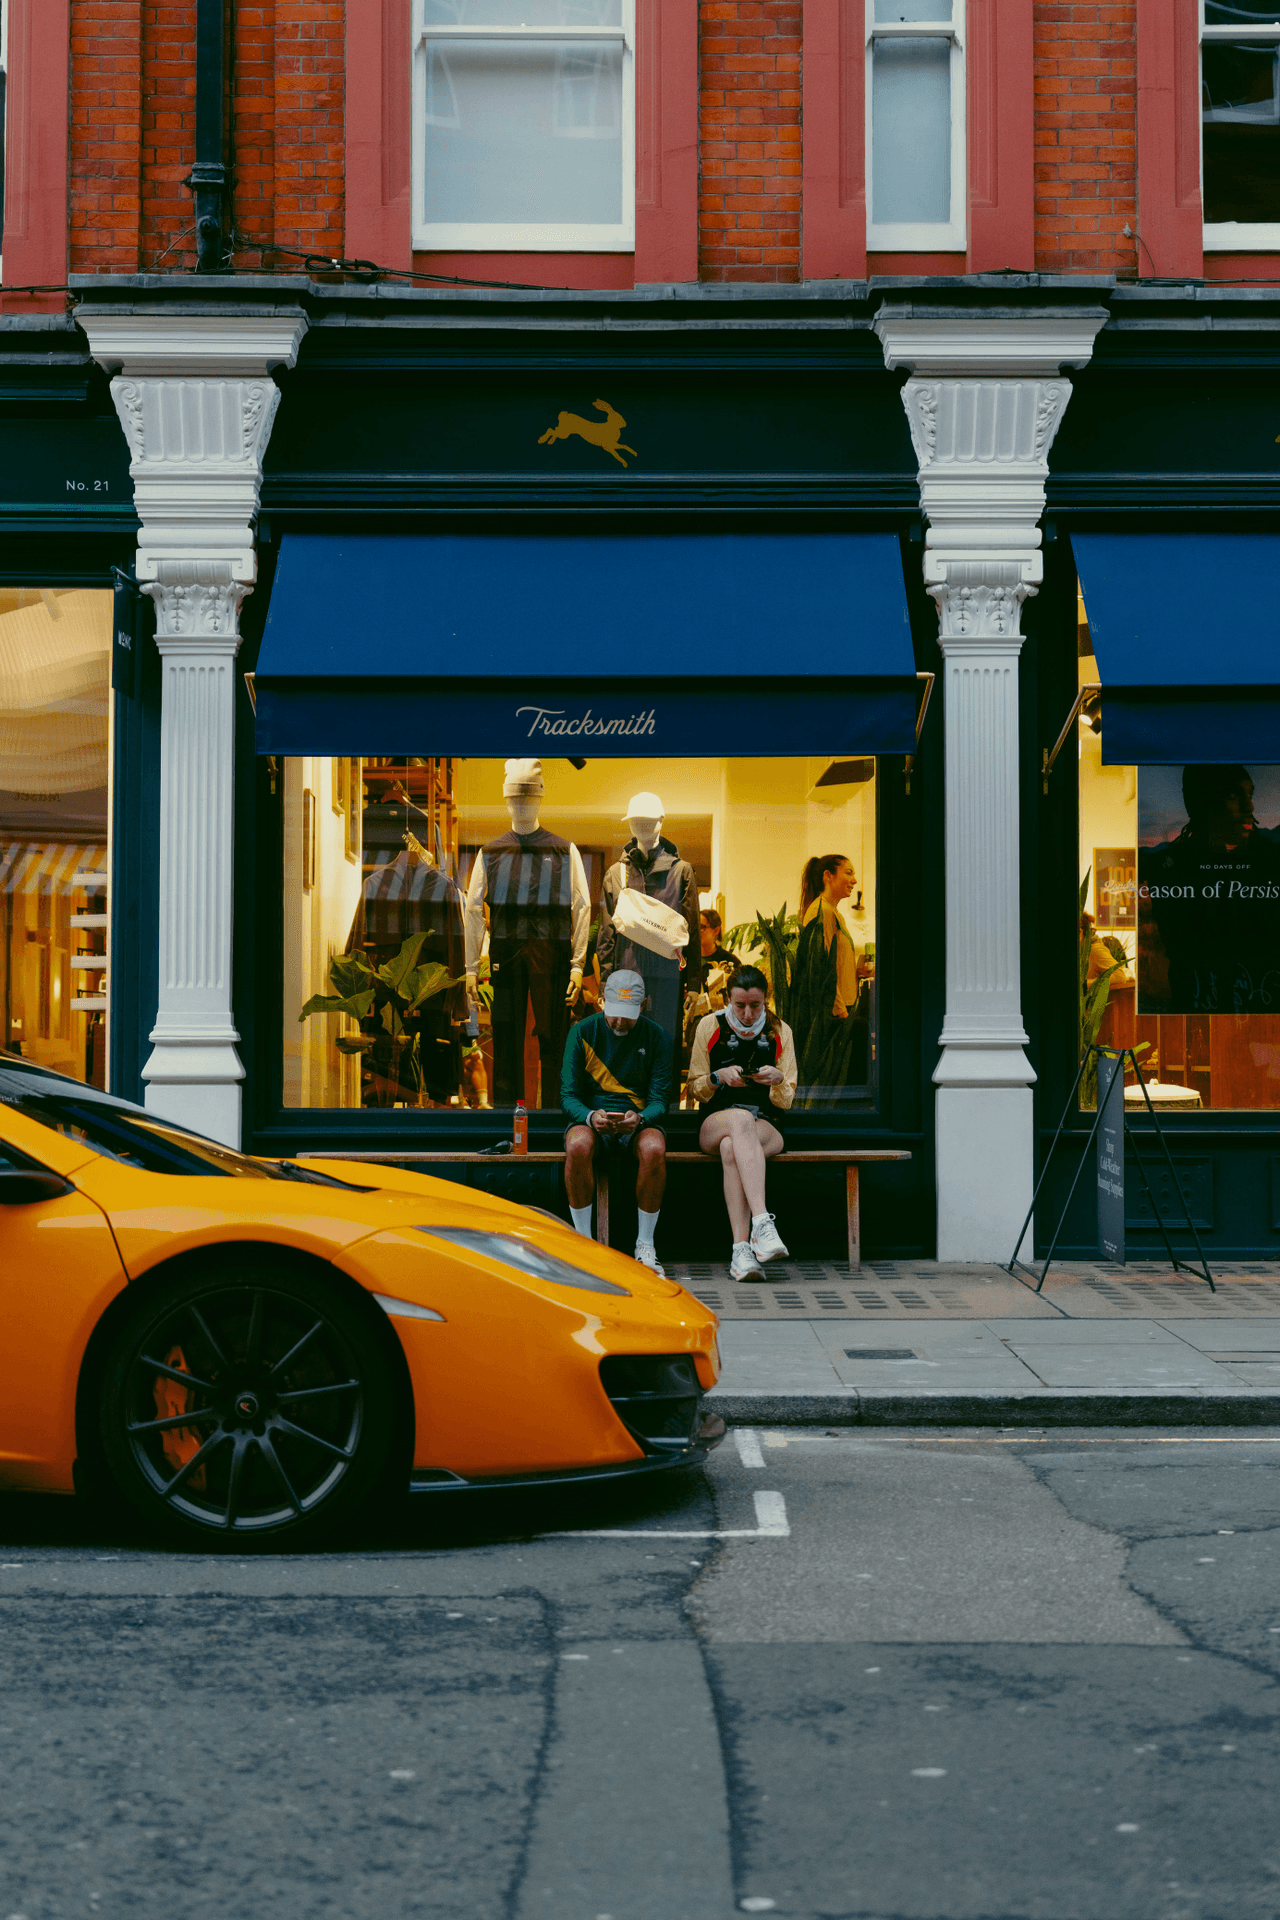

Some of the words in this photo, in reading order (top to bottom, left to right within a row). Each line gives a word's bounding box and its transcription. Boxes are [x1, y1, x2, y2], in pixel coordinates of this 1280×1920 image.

[66, 480, 89, 491] No.
[93, 480, 109, 491] 21
[515, 706, 656, 737] Tracksmith
[1127, 880, 1196, 899] Season
[1202, 880, 1224, 899] of
[1227, 880, 1280, 899] Persis
